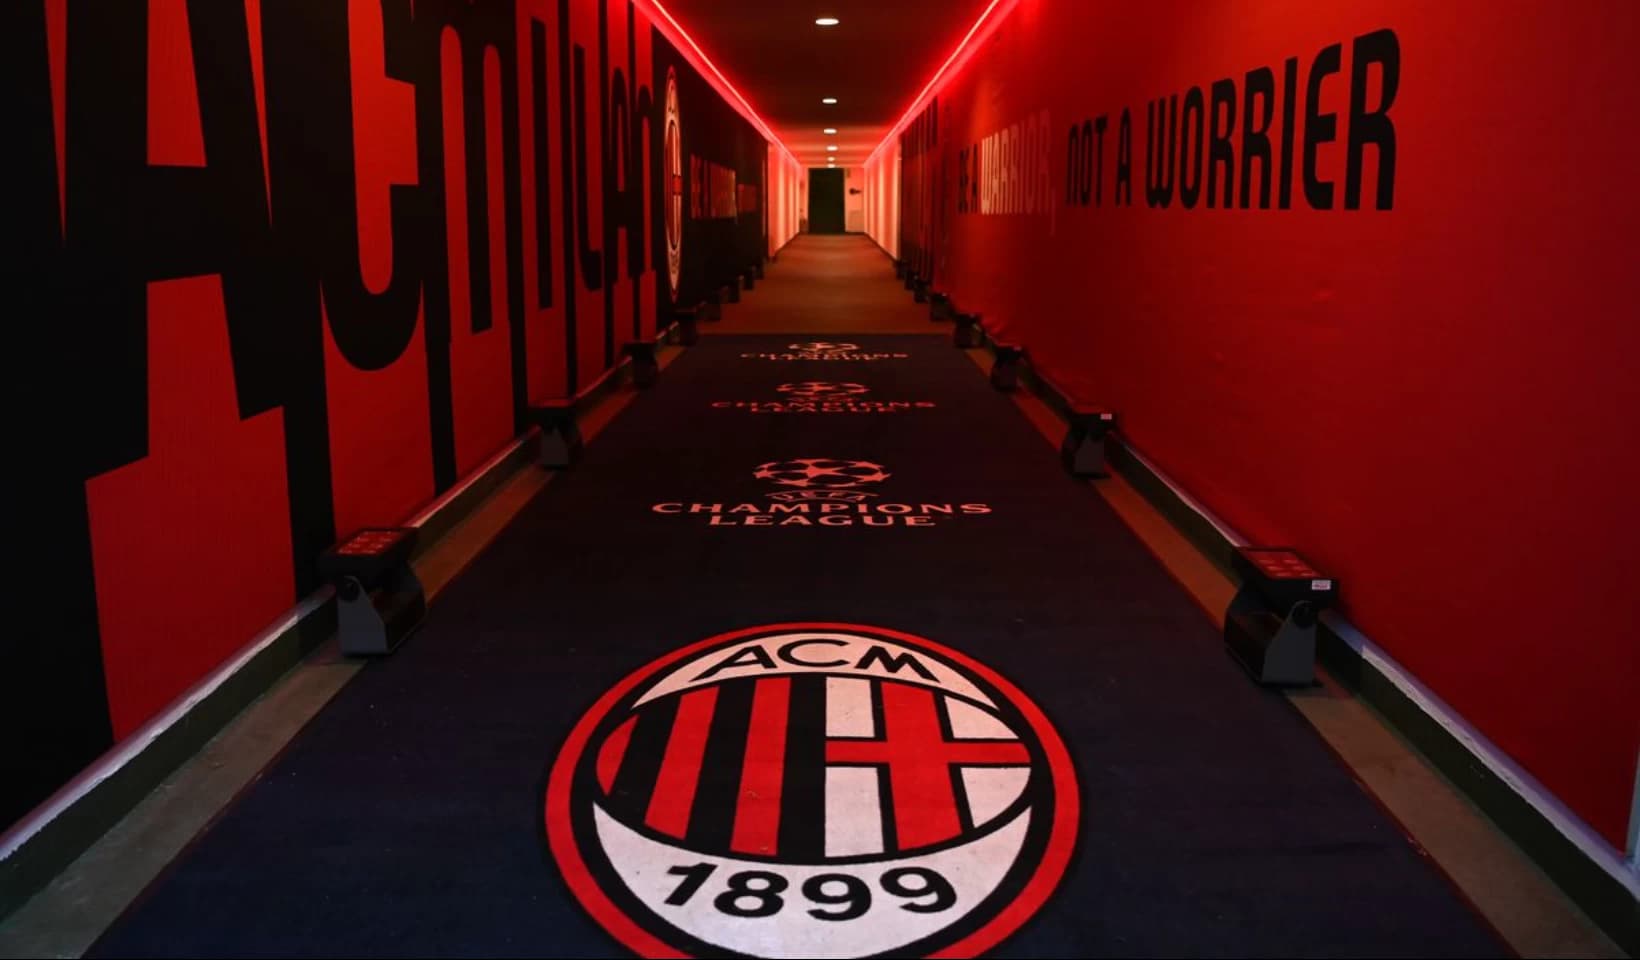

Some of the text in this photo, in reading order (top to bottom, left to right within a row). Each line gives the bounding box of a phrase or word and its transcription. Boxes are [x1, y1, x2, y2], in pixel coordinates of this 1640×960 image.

[1115, 106, 1133, 207] A
[1146, 28, 1400, 211] WORRIER
[651, 503, 993, 514] CHAMPIONS
[709, 515, 936, 527] LEAGUE
[688, 638, 942, 684] ACM
[663, 862, 958, 922] 1899
